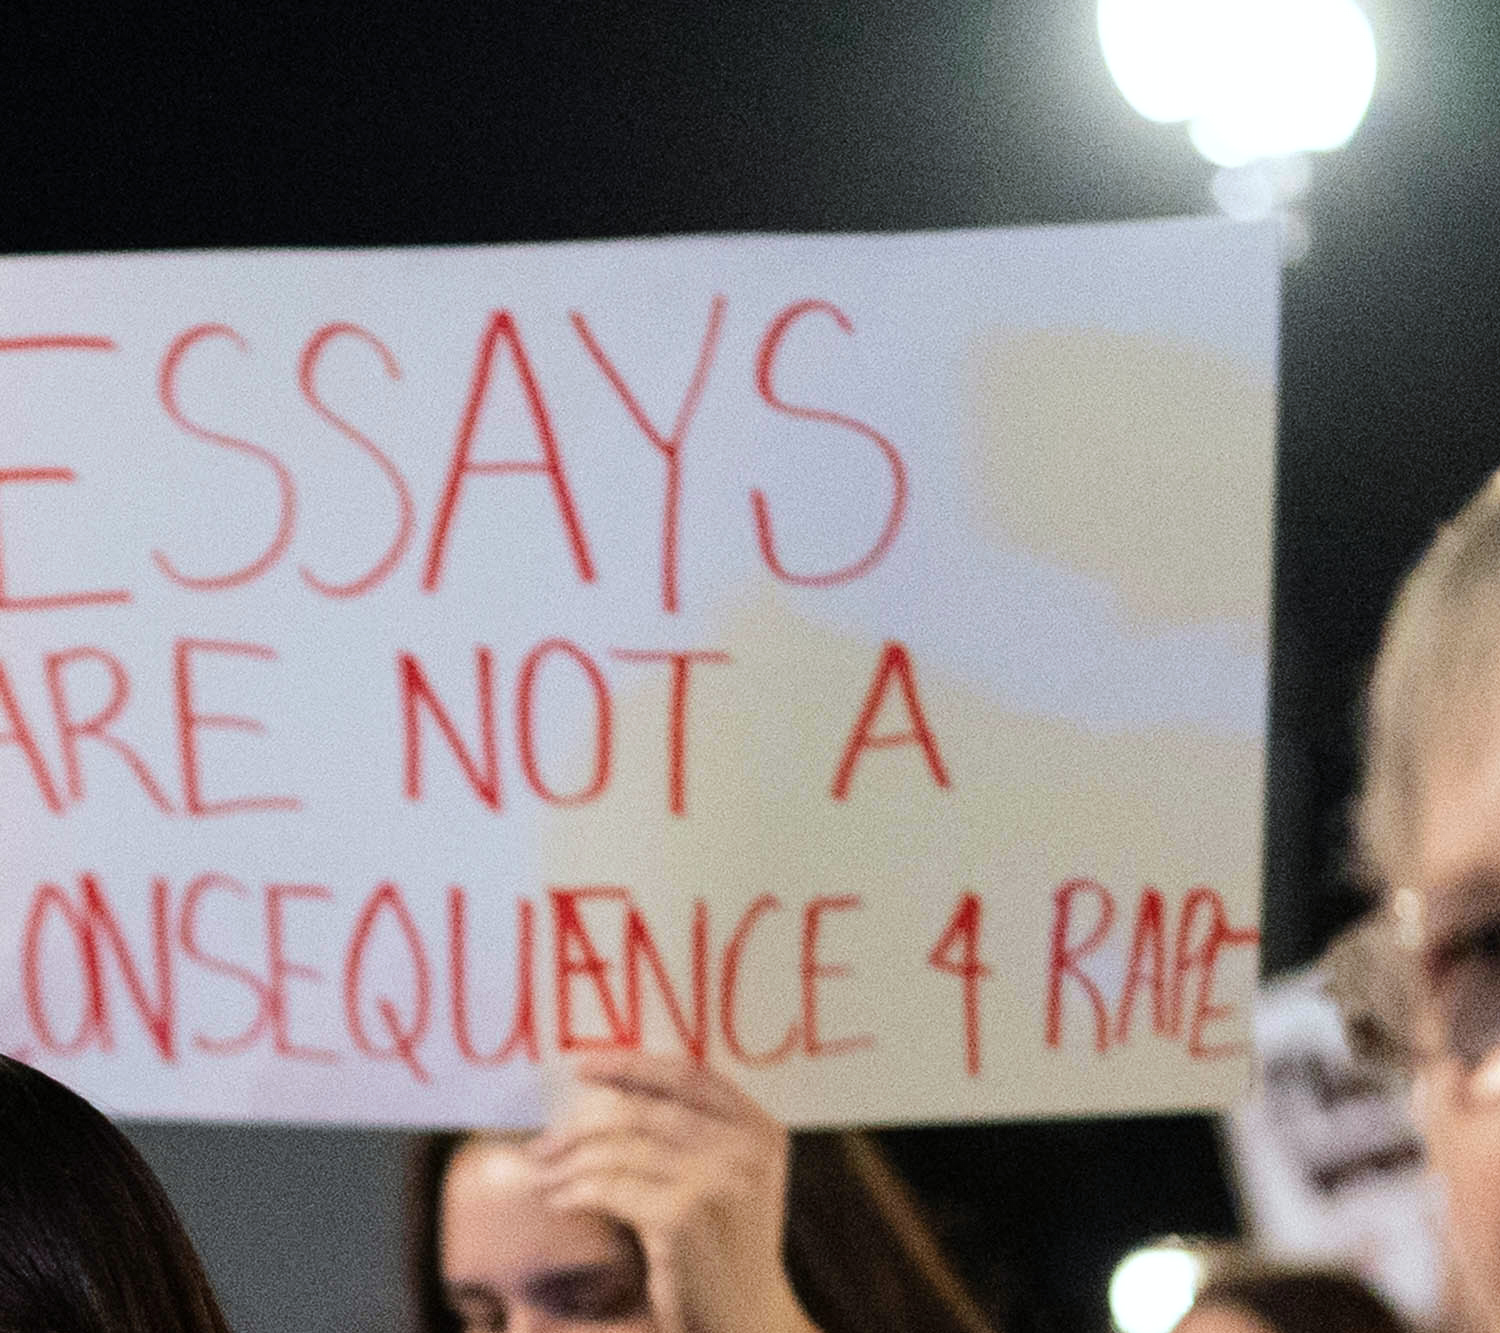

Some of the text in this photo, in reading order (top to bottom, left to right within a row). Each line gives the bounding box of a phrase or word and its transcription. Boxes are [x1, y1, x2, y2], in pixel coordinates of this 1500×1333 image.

[398, 636, 733, 817] NOT
[829, 642, 951, 803] A
[928, 888, 993, 1077] 4
[1043, 878, 1260, 1061] RAPE
